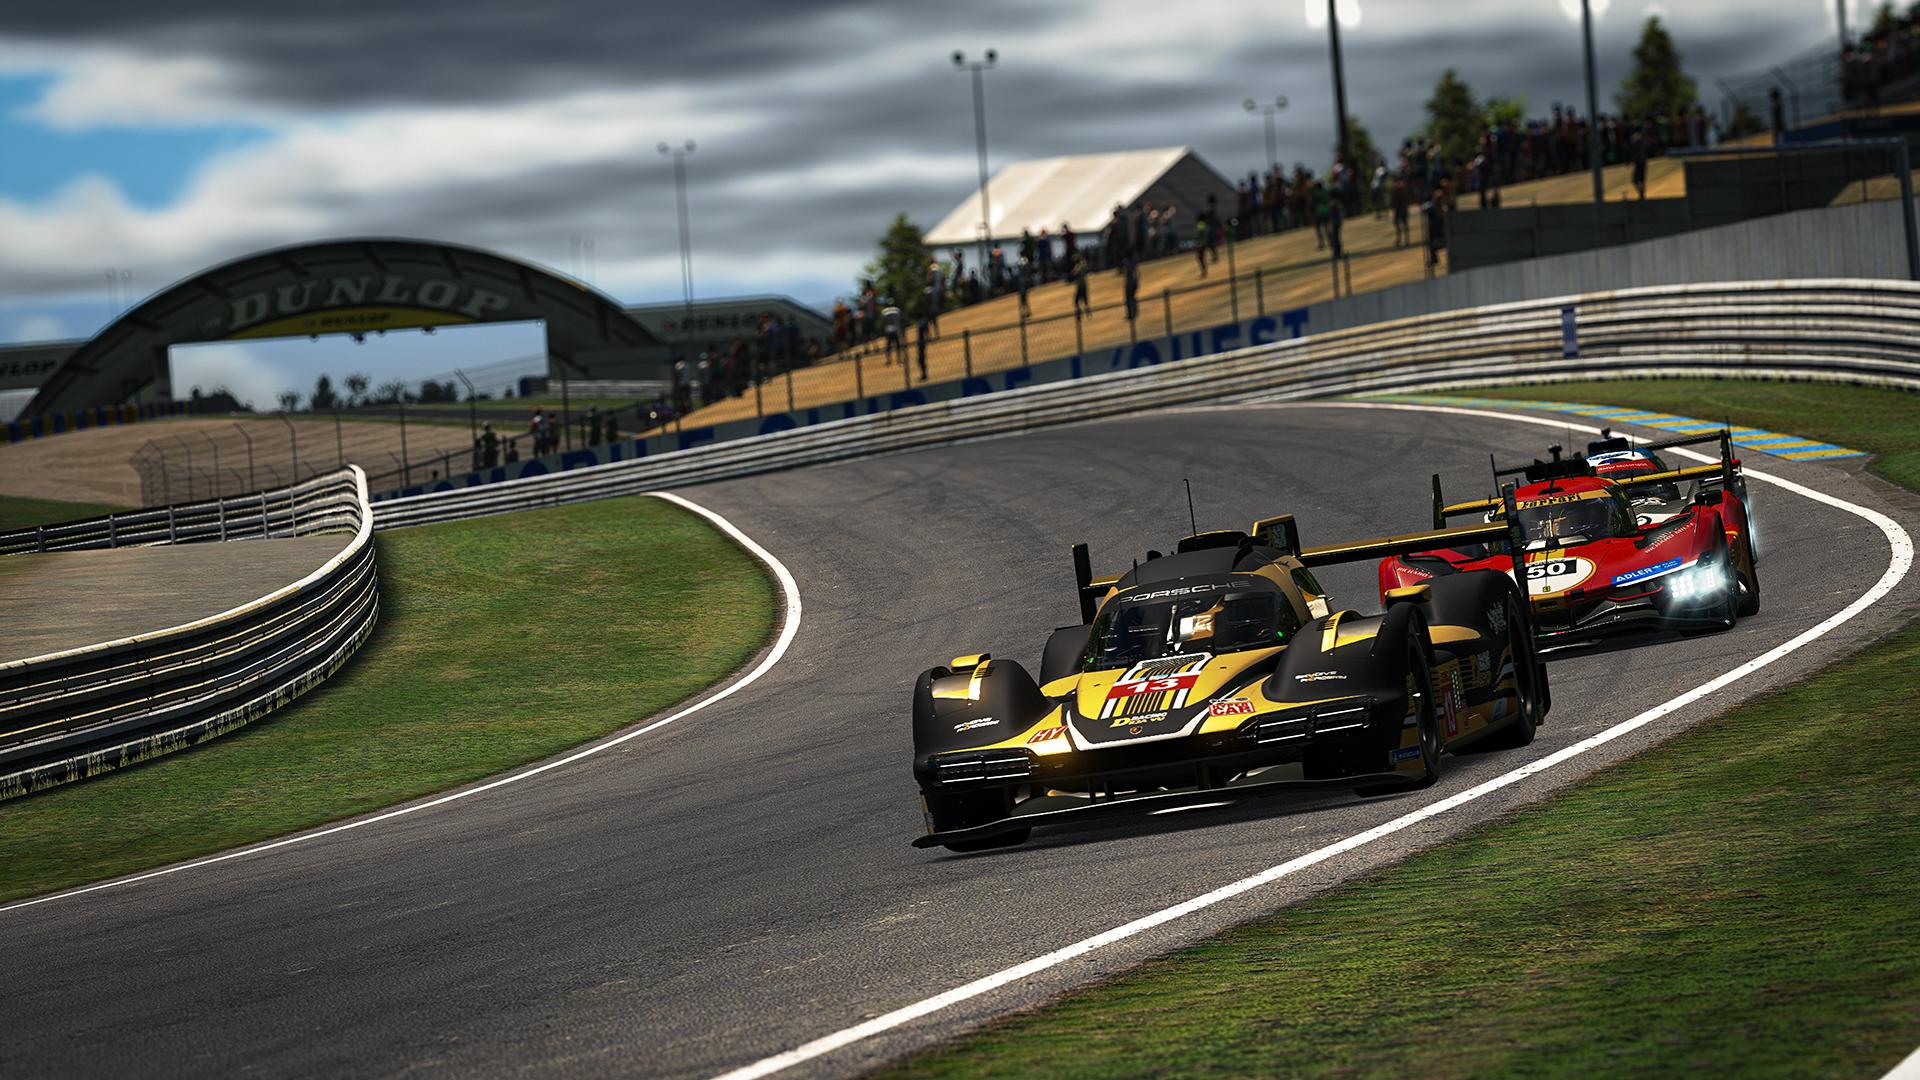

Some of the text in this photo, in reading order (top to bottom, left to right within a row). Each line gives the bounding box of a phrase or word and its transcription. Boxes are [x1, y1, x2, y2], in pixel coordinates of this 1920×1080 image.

[230, 275, 509, 328] DUNLOP
[1526, 562, 1567, 579] 50
[1616, 567, 1653, 582] ADLER
[1120, 580, 1250, 603] PORSCHE
[1127, 678, 1179, 694] 13
[1213, 705, 1251, 715] CAR
